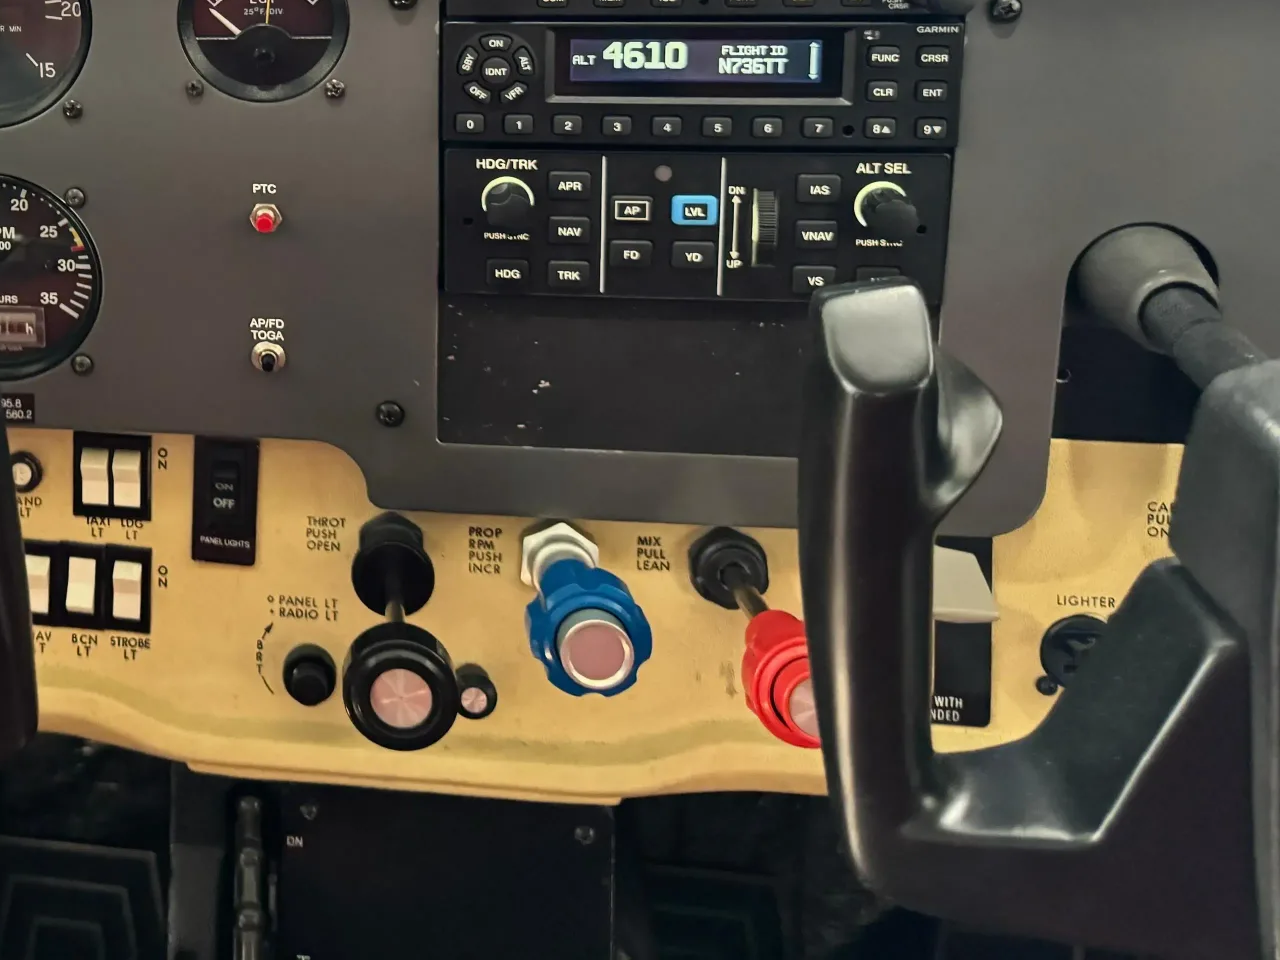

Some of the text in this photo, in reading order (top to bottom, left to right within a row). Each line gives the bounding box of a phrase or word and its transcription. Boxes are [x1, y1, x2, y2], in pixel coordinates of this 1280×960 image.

[61, 1, 81, 17] 20
[917, 25, 959, 33] GARMIN
[602, 41, 689, 70] 4610
[722, 45, 788, 56] FLIGHT ID
[871, 54, 900, 63] FUNC
[921, 54, 949, 63] CRSR
[485, 67, 507, 76] IDNT
[719, 58, 789, 75] N736TT
[476, 159, 538, 170] HDG/TRK
[856, 163, 912, 174] ALT SEL
[253, 184, 276, 194] PTC
[558, 181, 582, 191] APR
[10, 199, 28, 211] 20
[624, 206, 640, 215] AP
[684, 207, 705, 217] LVL
[802, 231, 834, 241] VNAV
[495, 269, 521, 279] HDG
[40, 293, 58, 304] 35
[250, 318, 284, 328] AP/FD
[251, 330, 284, 340] TOGA
[213, 497, 235, 509] OFF
[307, 516, 346, 528] THROT
[306, 528, 336, 540] PUSH
[469, 527, 502, 538] PROP
[200, 535, 224, 546] PANEL
[306, 540, 341, 551] OPEN
[637, 536, 661, 546] MIX
[637, 560, 670, 571] LEAN
[1056, 594, 1115, 608] LIGHTER
[110, 636, 151, 649] STROBE
